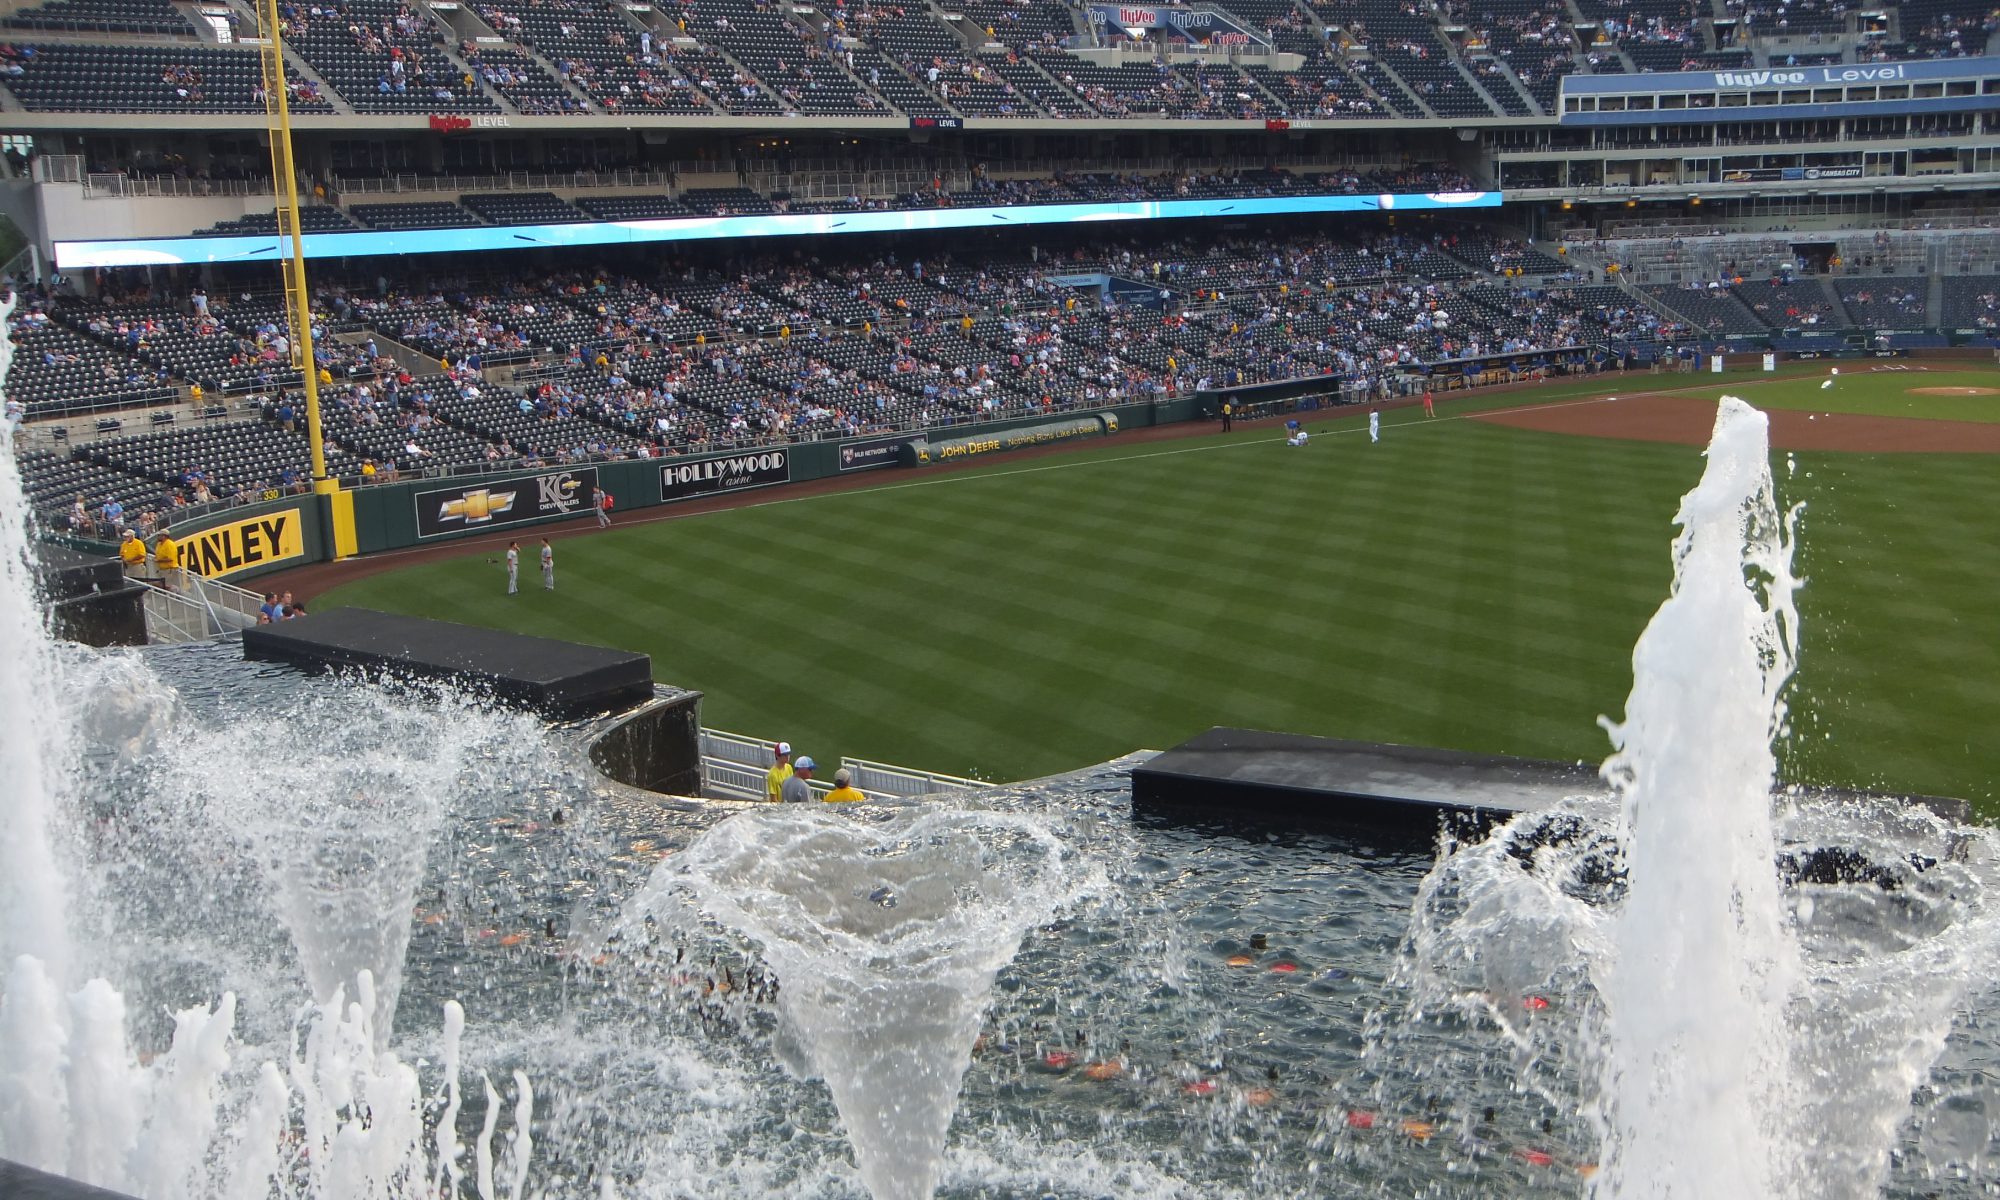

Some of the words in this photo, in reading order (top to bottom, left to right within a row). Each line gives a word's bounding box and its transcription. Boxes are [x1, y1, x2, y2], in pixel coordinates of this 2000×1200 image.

[1120, 8, 1156, 26] HyVee
[1170, 11, 1212, 28] HyVee
[1715, 71, 1805, 87] HyVee
[1823, 65, 1904, 82] Level
[477, 116, 510, 127] LEVEL
[939, 119, 957, 127] LEVEL
[1292, 120, 1312, 128] LEVEL
[940, 445, 967, 458] JOHN
[968, 439, 1000, 454] DEERE
[1056, 428, 1071, 438] Like
[1071, 427, 1078, 435] A
[664, 452, 785, 486] HOLLYWOOD
[717, 468, 752, 488] Casino
[264, 489, 278, 500] 330
[537, 472, 575, 513] KC
[539, 502, 557, 511] CHEVY
[177, 516, 286, 577] TANLEY
